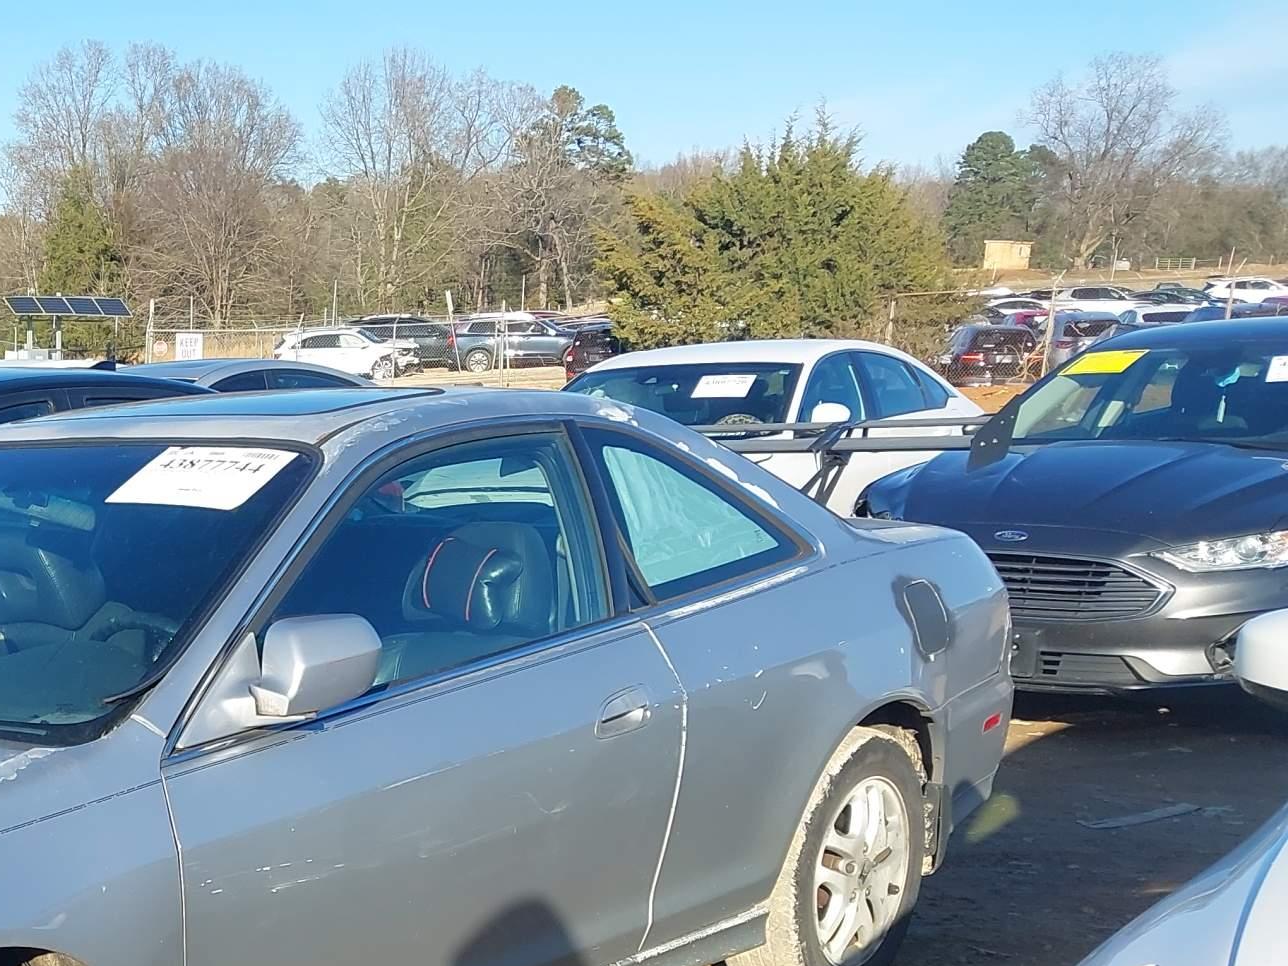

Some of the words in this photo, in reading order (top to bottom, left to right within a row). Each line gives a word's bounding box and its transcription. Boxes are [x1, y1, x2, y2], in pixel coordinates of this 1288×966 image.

[179, 337, 199, 348] KEEP
[181, 348, 197, 359] OUT
[160, 459, 265, 474] 43877744
